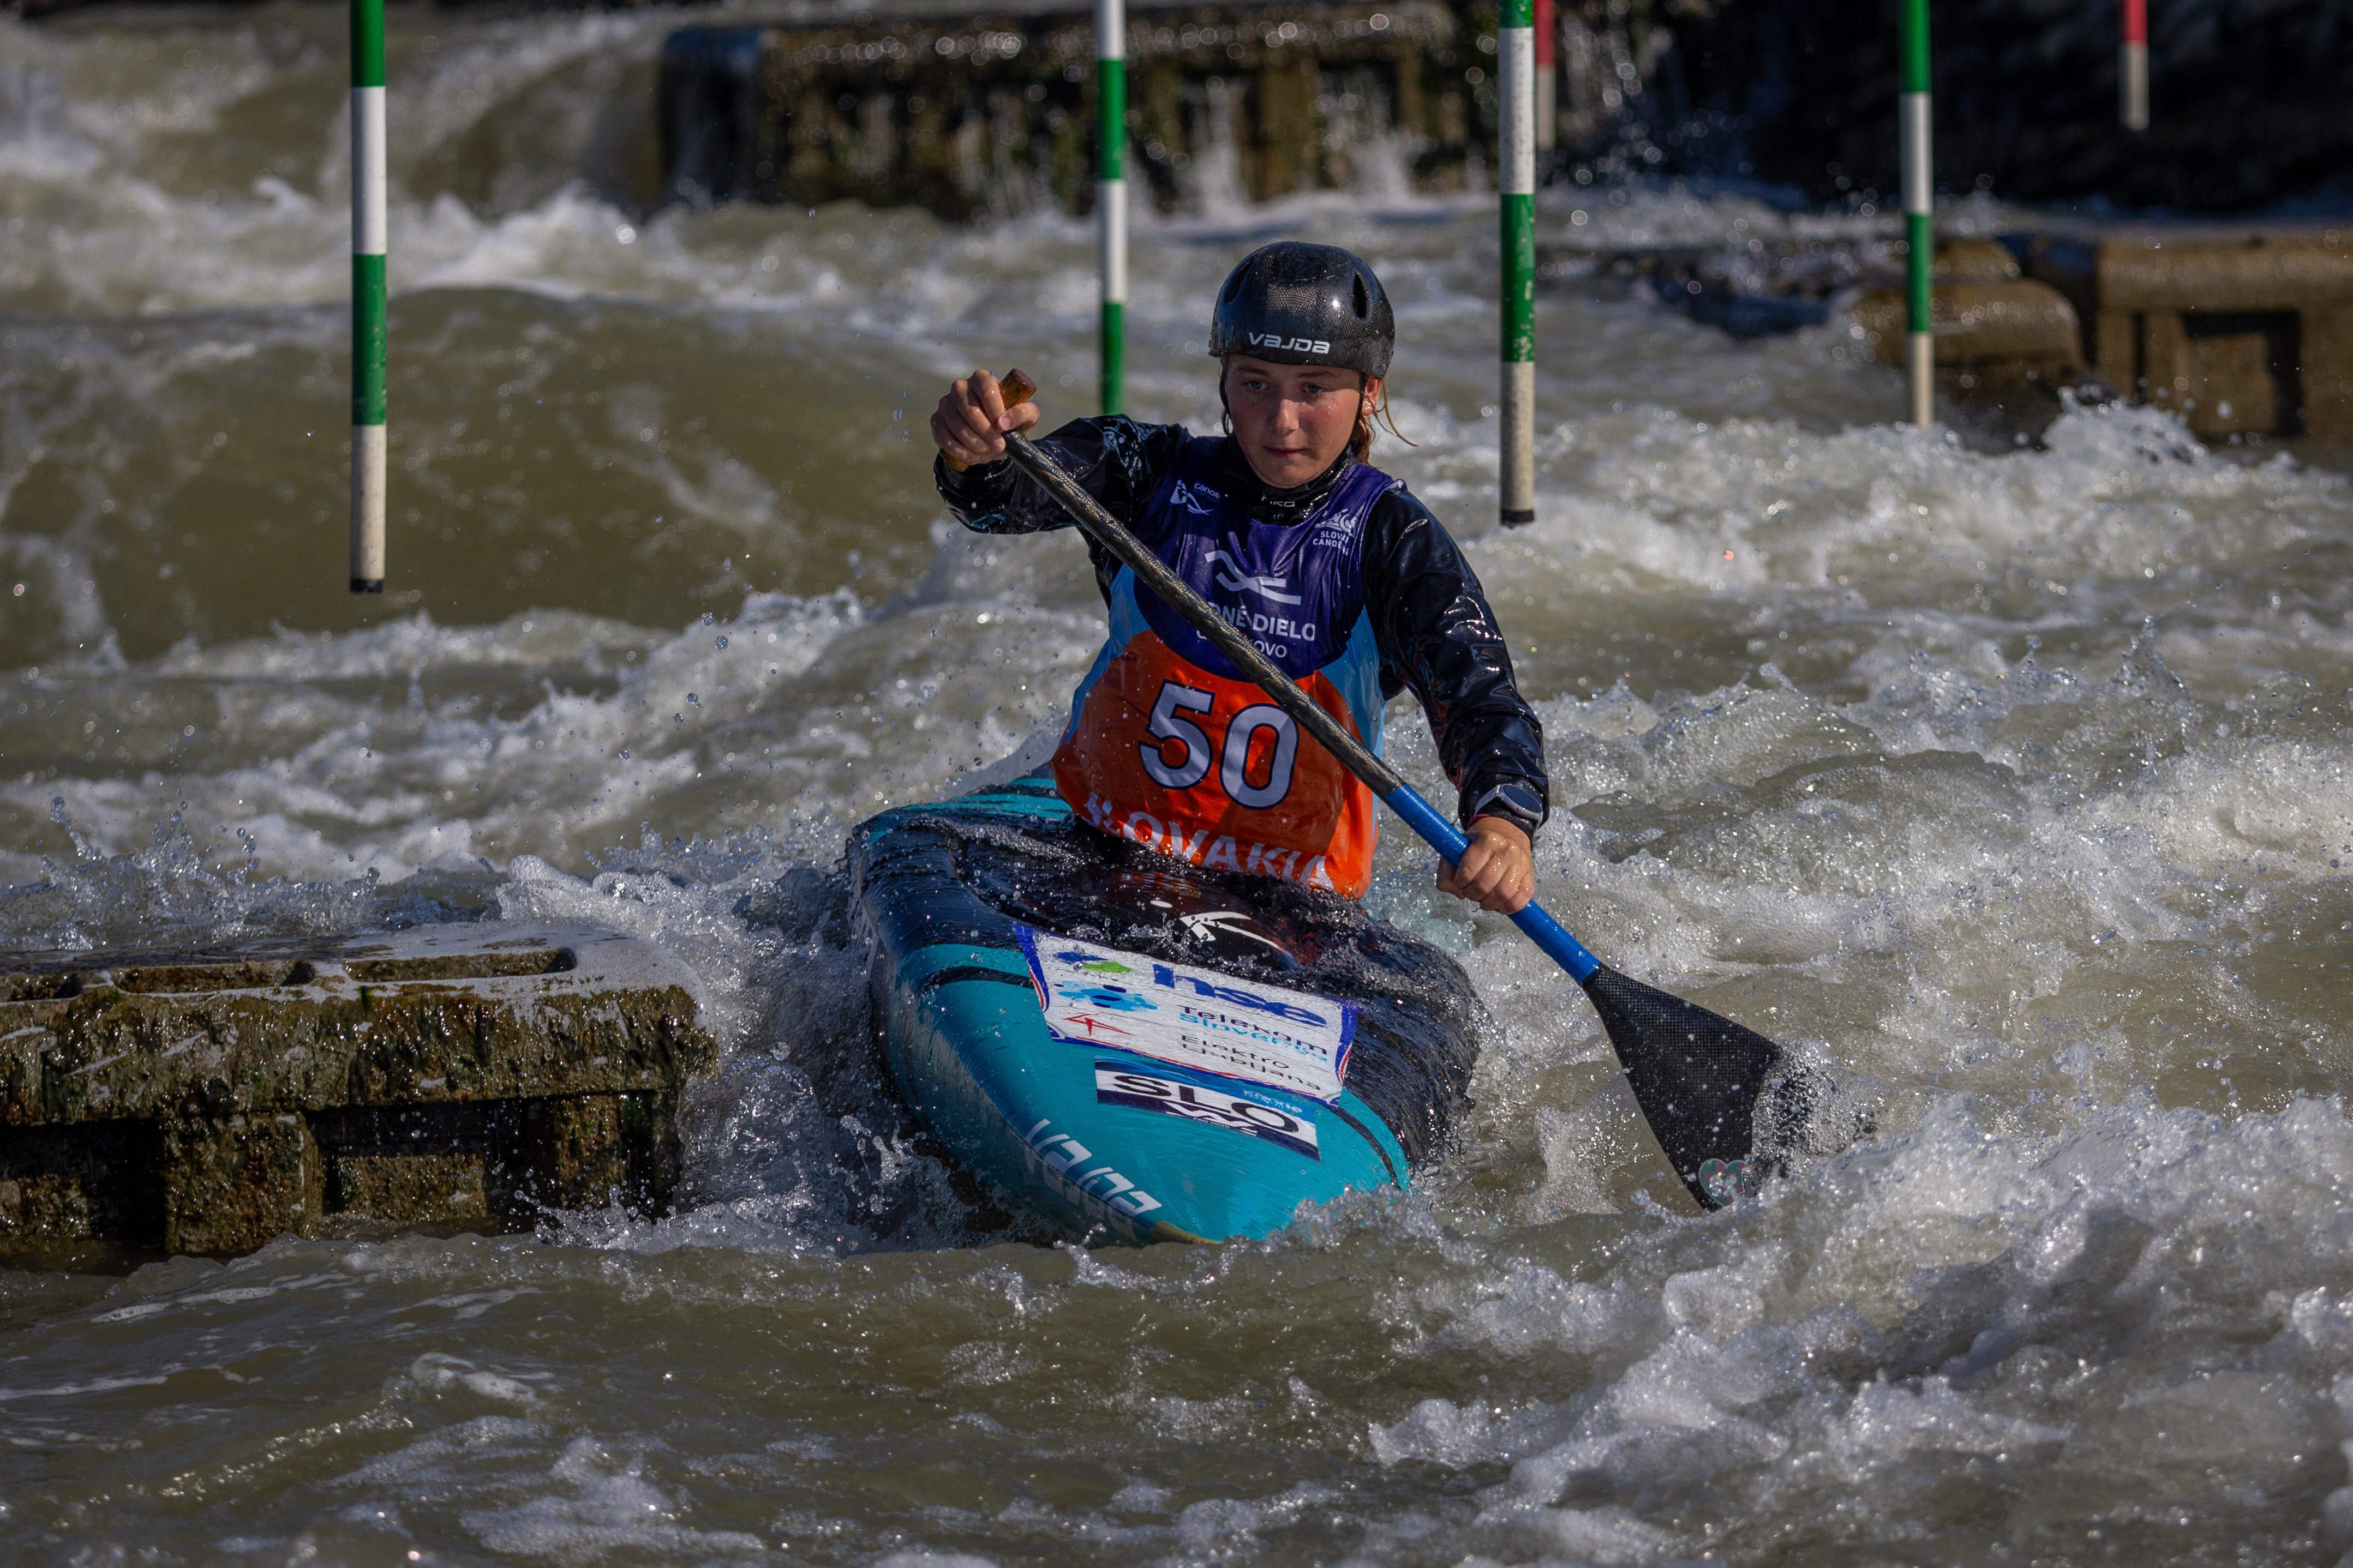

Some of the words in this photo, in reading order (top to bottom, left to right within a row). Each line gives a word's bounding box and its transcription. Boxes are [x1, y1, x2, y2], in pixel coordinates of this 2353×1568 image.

[1194, 483, 1220, 499] canoe
[1252, 613, 1316, 641] DIELO
[1138, 678, 1300, 810] 50
[1176, 1004, 1327, 1055] Telekom
[1182, 1035, 1289, 1069] Elektro
[1113, 1075, 1299, 1133] SLO
